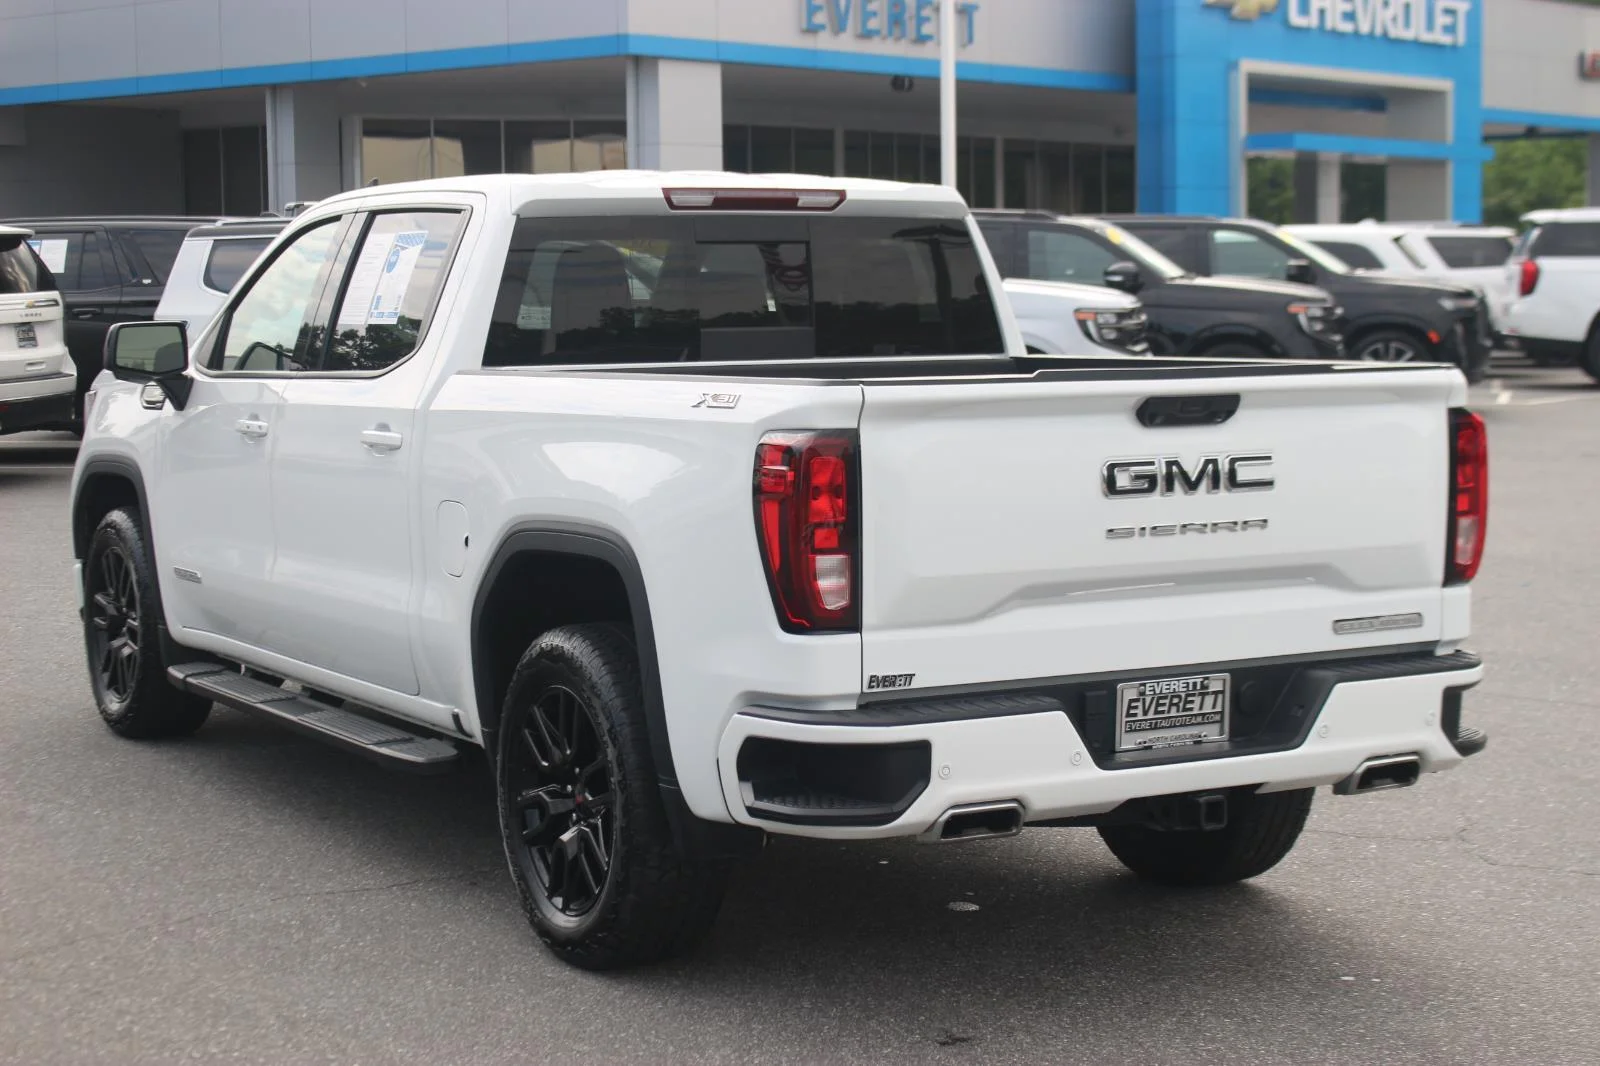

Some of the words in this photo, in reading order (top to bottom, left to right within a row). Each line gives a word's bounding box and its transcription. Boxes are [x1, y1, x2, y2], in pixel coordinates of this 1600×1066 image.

[804, 0, 979, 46] EVERET
[1287, 0, 1472, 47] CHEVROLET
[1102, 451, 1275, 499] GMC
[1105, 518, 1268, 539] SIERRA
[867, 673, 916, 689] EVERETT
[1145, 678, 1203, 695] EVERETT
[1125, 690, 1224, 718] EVERETT
[1125, 713, 1221, 731] EVERETTAUTOTEAM.COM
